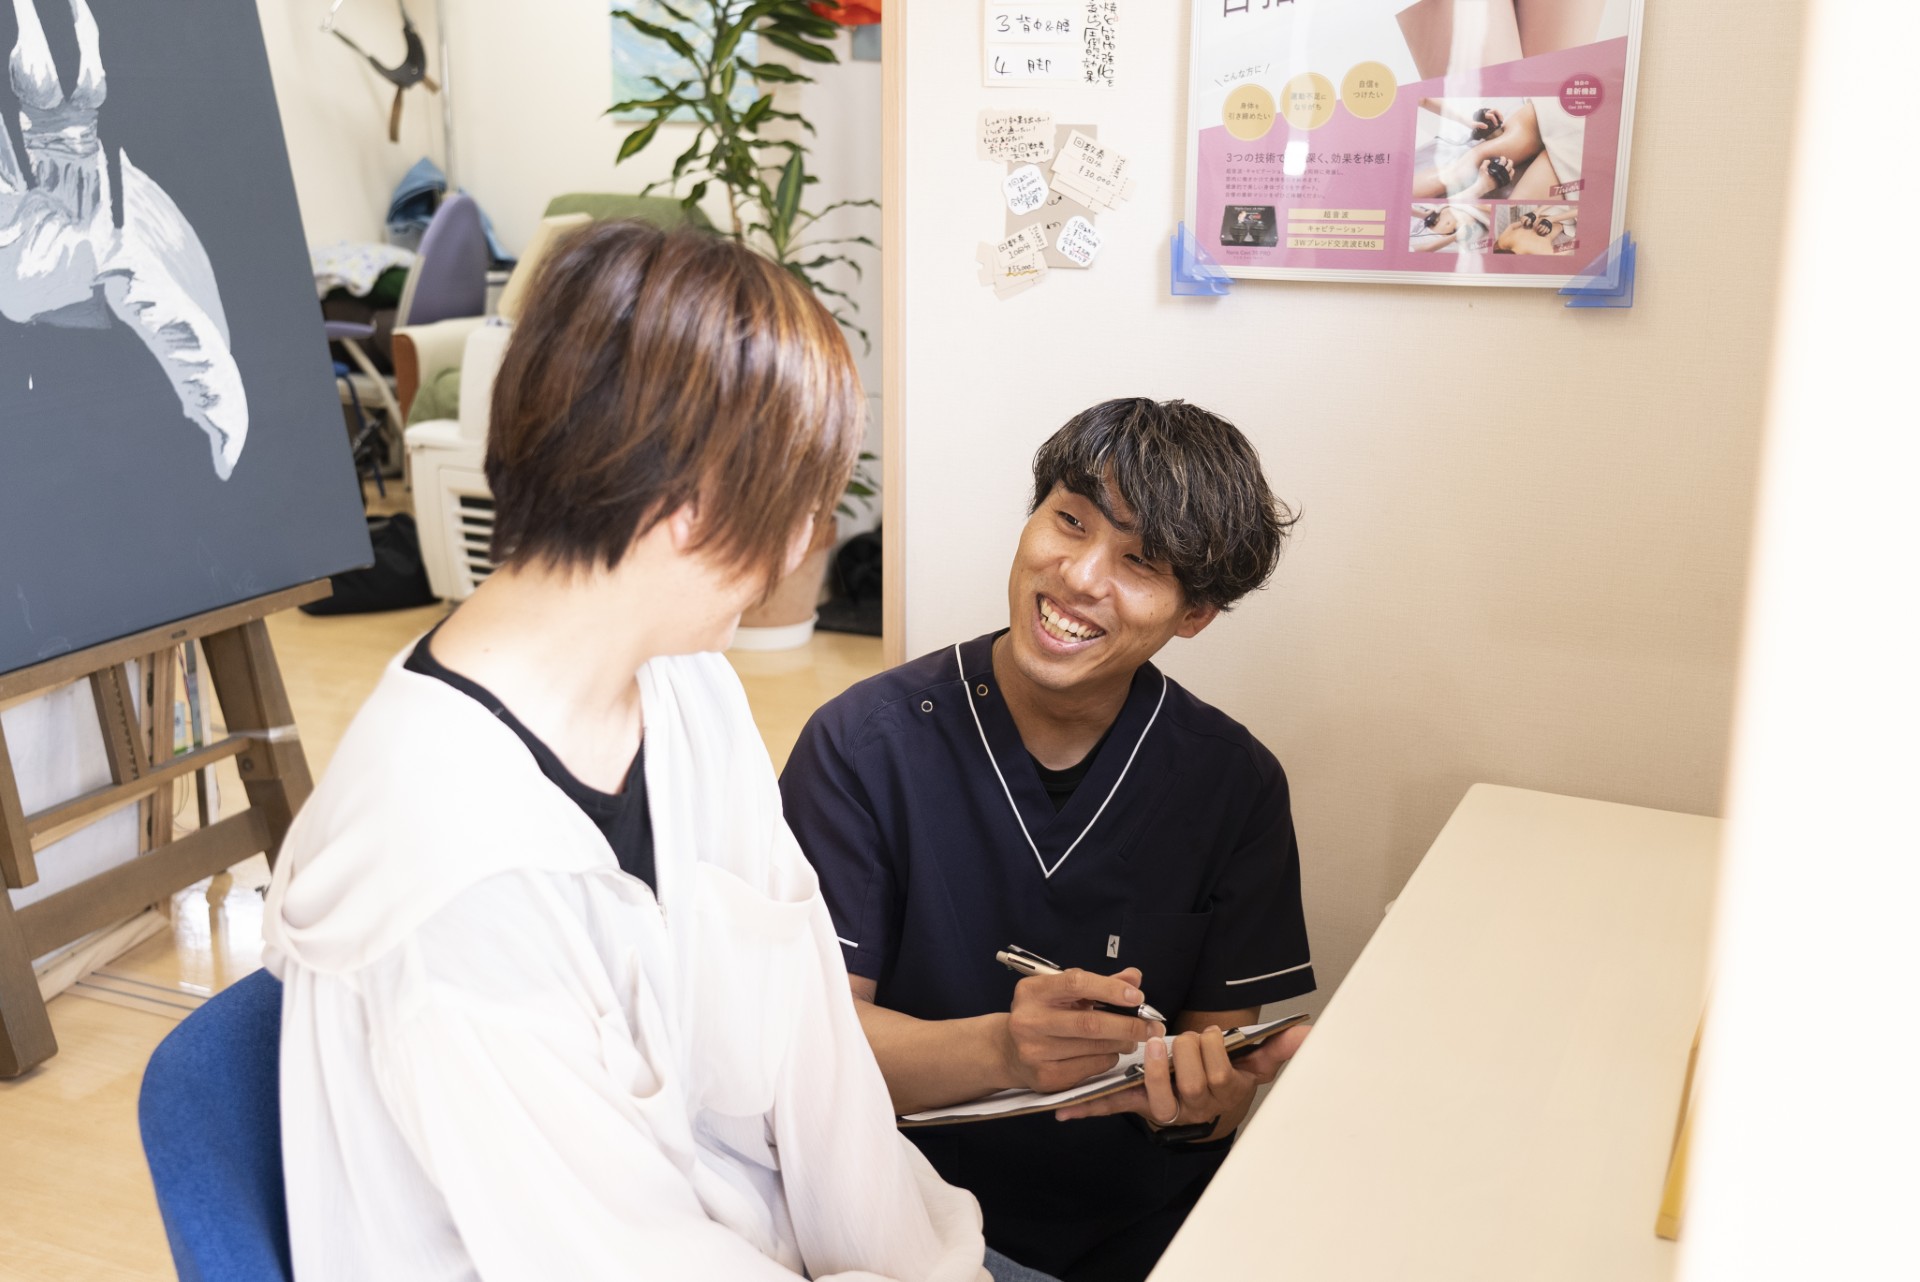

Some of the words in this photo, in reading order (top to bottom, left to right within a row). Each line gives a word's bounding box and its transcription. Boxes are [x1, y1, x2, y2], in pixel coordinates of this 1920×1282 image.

[996, 15, 1011, 32] 3
[994, 56, 1012, 75] 4
[1027, 58, 1051, 73] 脚
[1358, 80, 1379, 89] 自信を
[1353, 91, 1384, 99] つけたい
[1228, 112, 1271, 121] 引き締めたい
[1226, 152, 1391, 165] 3つの技術で深く、効果を体感!
[1323, 211, 1349, 219] 超音波
[1307, 225, 1364, 233] キャビテーション
[1294, 239, 1376, 248] 3Wブレンド交流波EMS
